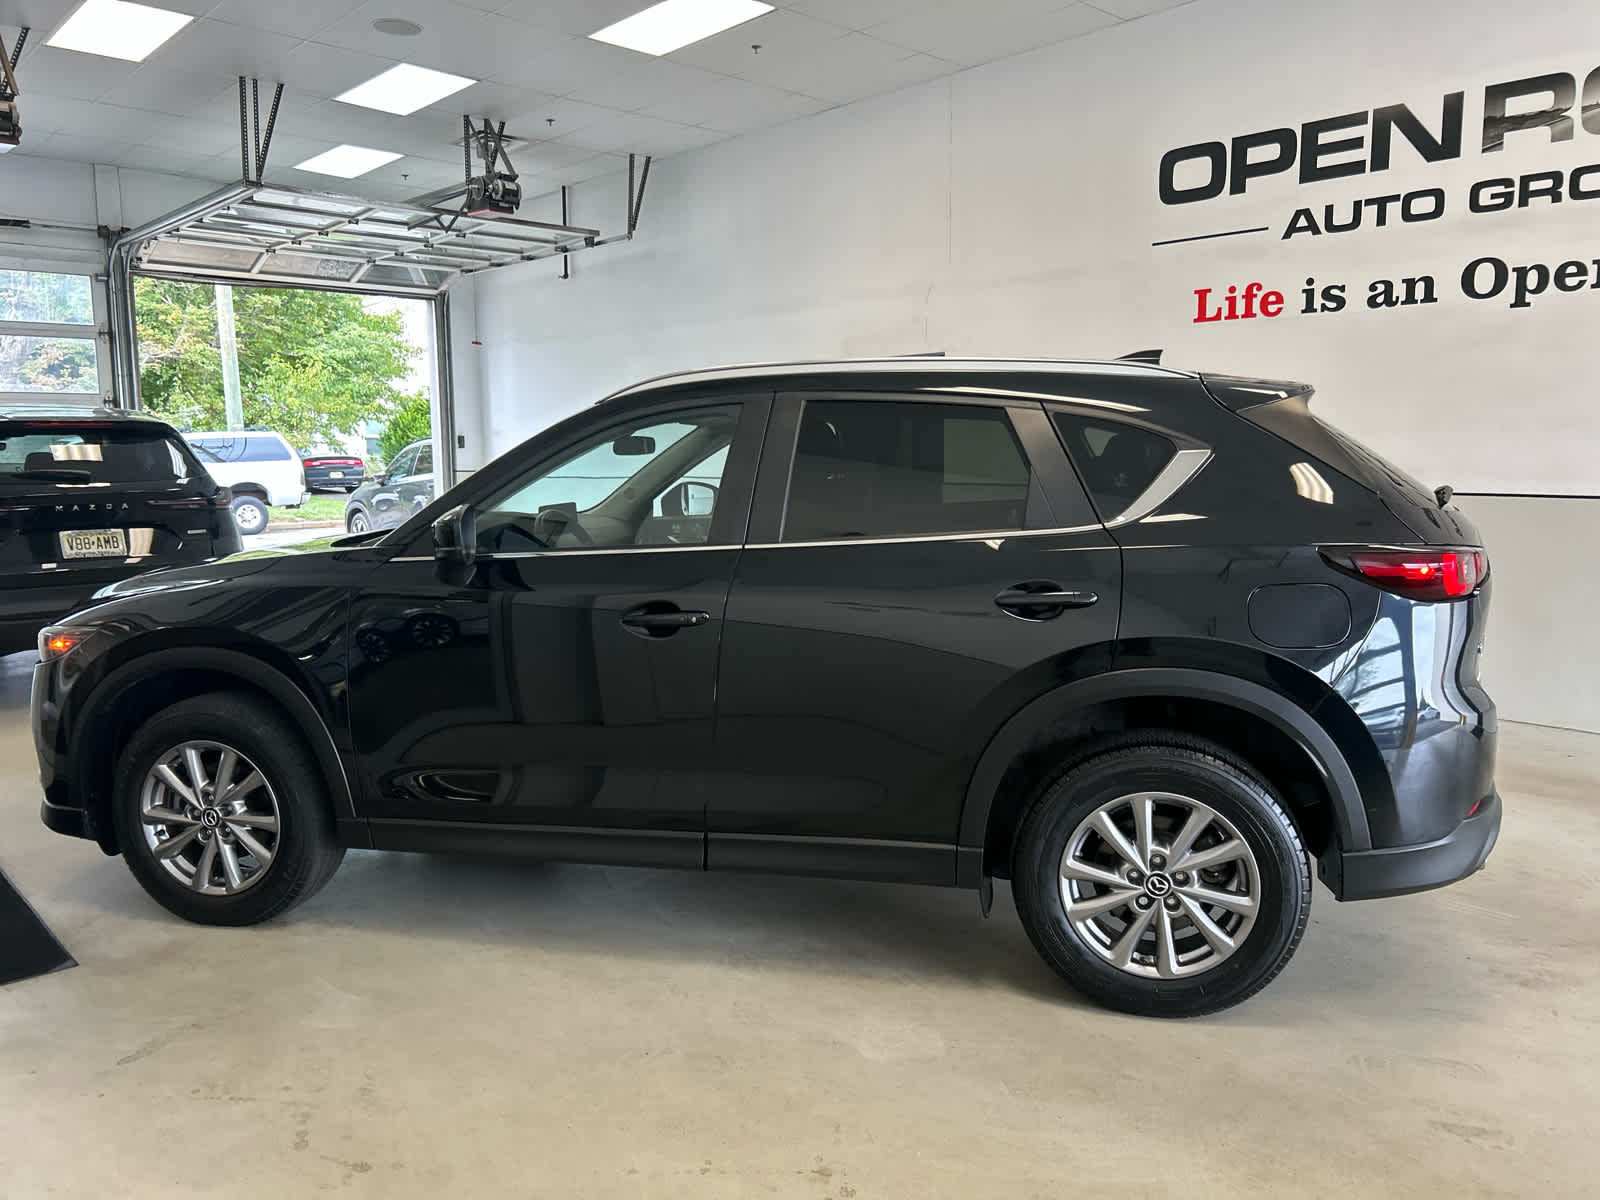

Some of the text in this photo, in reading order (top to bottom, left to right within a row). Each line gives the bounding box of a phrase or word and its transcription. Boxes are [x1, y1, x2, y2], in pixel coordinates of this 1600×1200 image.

[1158, 65, 1600, 206] OPEN R
[1280, 187, 1446, 241] AUTO
[1192, 256, 1600, 324] Life is an Ope
[55, 503, 129, 512] MAZDA
